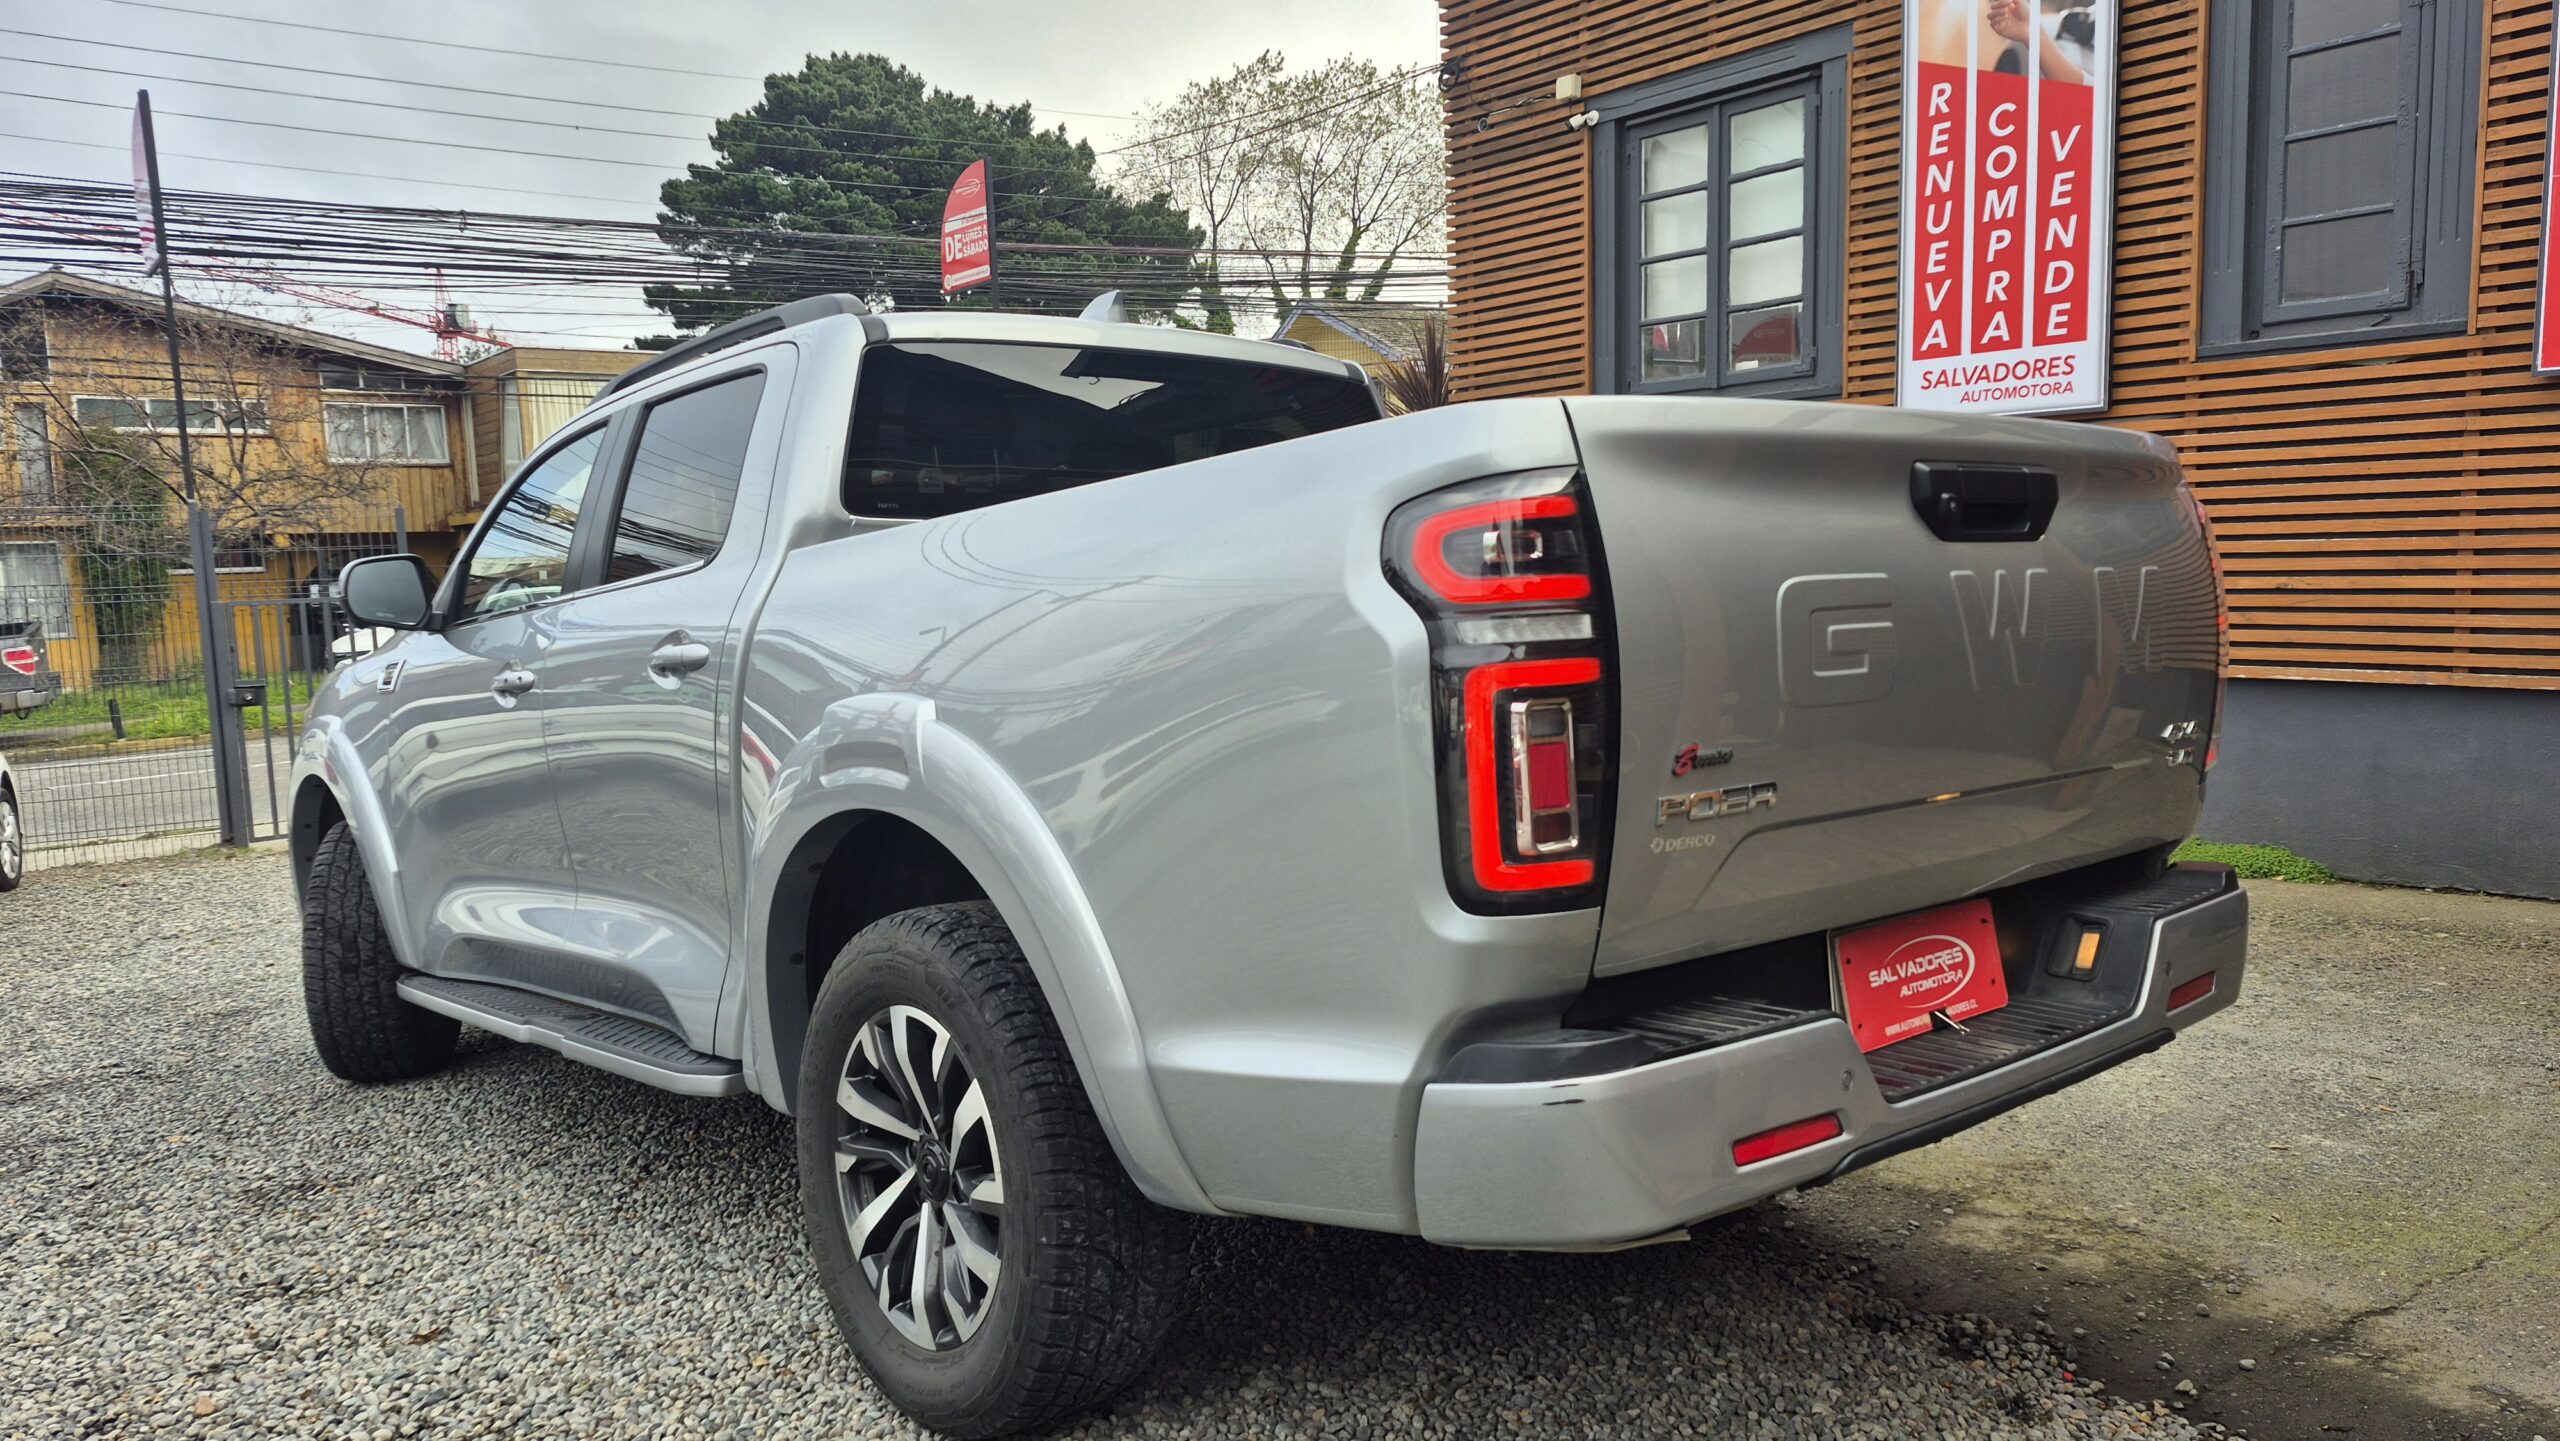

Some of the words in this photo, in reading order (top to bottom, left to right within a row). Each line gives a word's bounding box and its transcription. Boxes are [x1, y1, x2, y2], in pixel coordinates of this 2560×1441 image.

[963, 226, 982, 243] LUNES
[1920, 82, 1954, 351] RENUEVA
[1979, 102, 2019, 344] COMPRA
[2043, 124, 2082, 337] VENDE
[944, 234, 964, 263] DE
[1920, 354, 2077, 390] SALVADORES
[1959, 381, 2075, 404] AUTOMOTORA
[1655, 782, 1778, 828] POER
[1664, 834, 1716, 852] DERCO
[1868, 946, 1964, 988] SALVADORES
[1899, 968, 1964, 998] AUTOMOTORA
